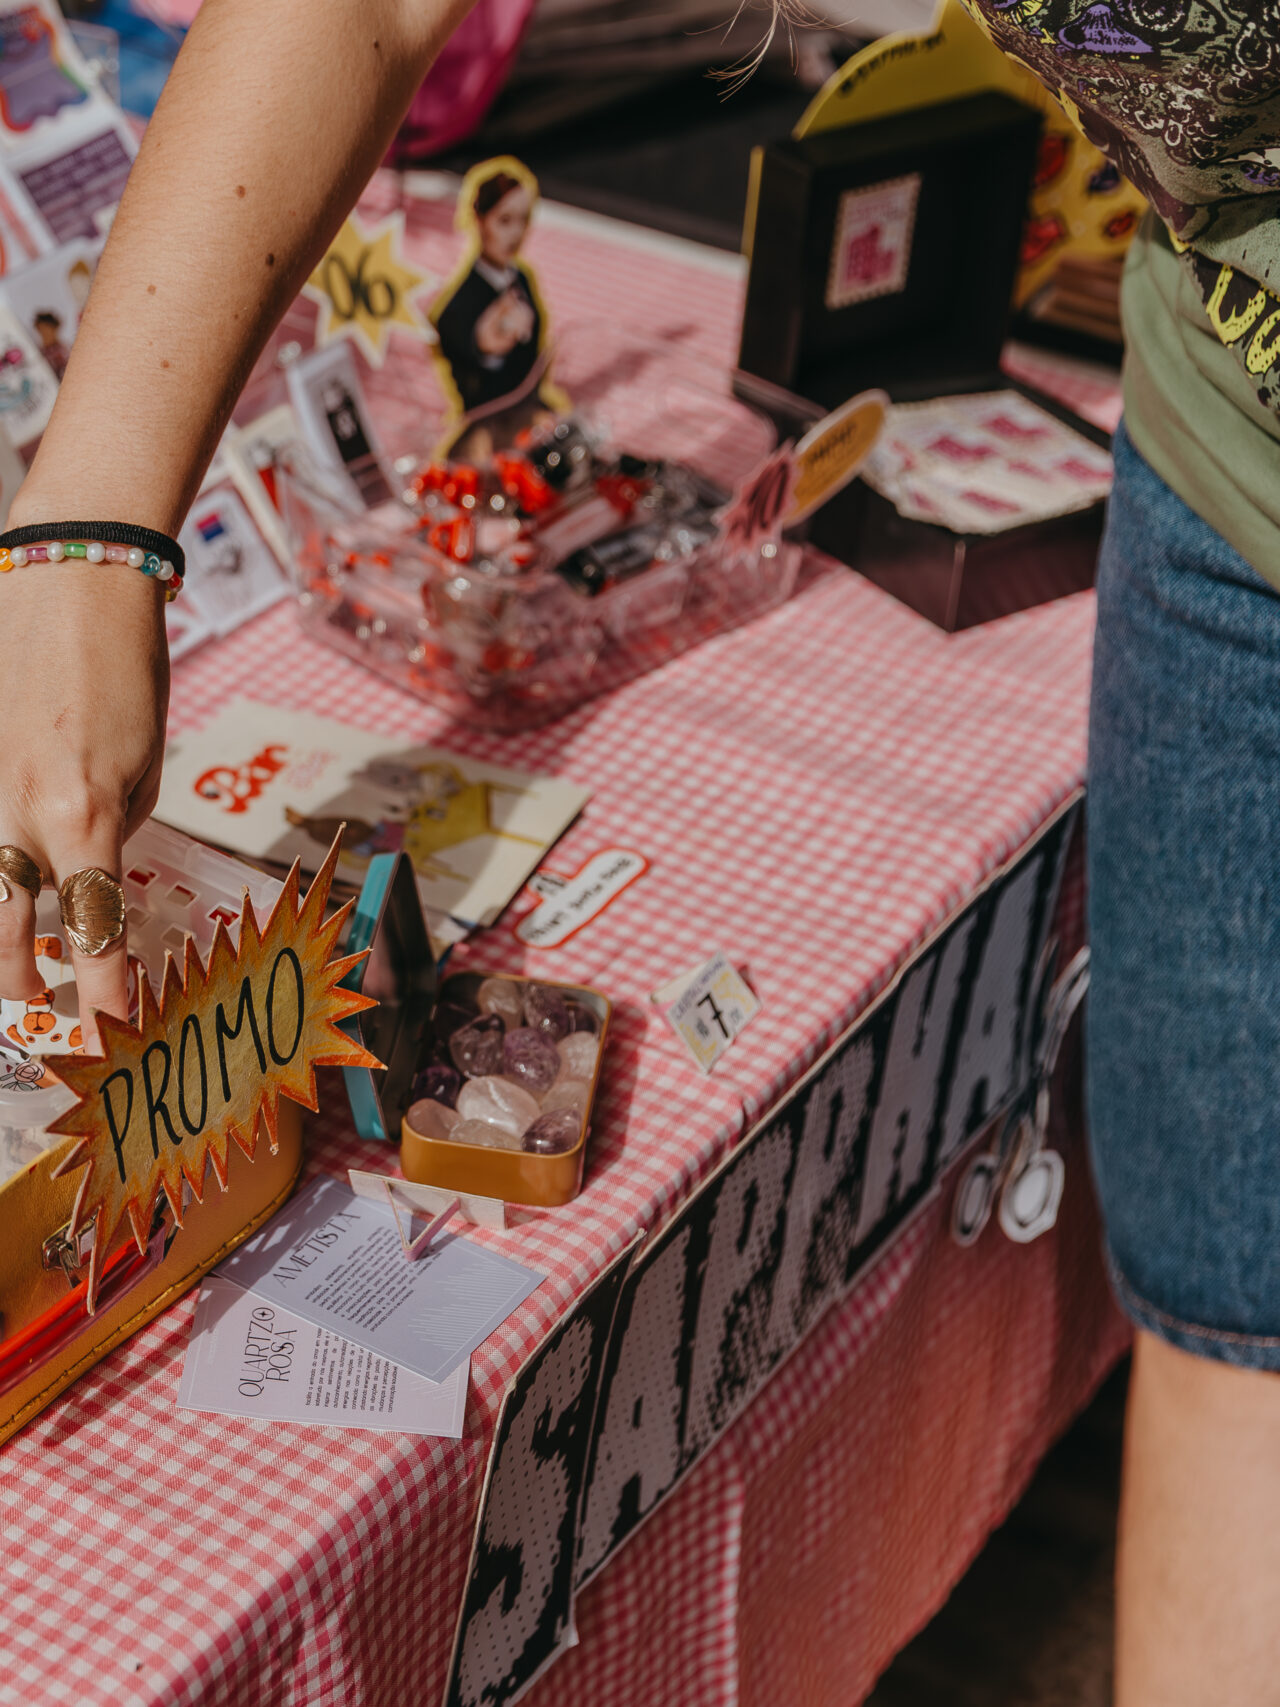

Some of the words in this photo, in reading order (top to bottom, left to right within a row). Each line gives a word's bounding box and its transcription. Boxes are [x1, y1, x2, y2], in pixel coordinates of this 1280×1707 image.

[323, 246, 396, 320] 06
[697, 992, 728, 1038] 7
[99, 948, 304, 1184] PROMO
[273, 1213, 361, 1288] AMETISTA
[238, 1307, 275, 1397] QUARTZO
[265, 1329, 297, 1381] ROSA
